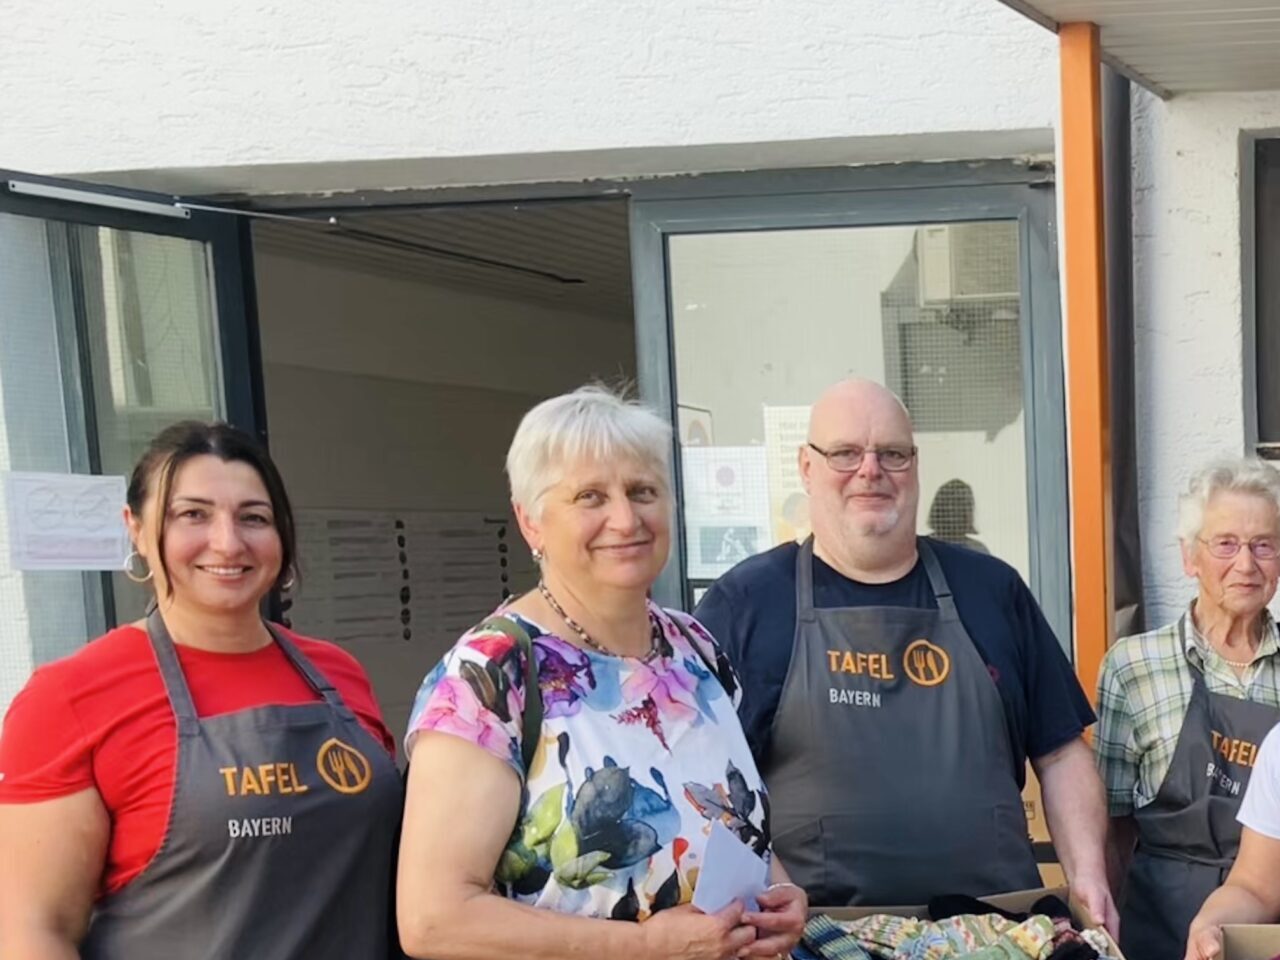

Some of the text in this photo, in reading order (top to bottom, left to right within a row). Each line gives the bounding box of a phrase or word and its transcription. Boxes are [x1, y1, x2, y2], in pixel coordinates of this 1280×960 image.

[827, 650, 894, 679] TAFEL
[829, 688, 881, 708] BAYERN
[219, 763, 309, 796] TAFEL
[228, 816, 292, 838] BAYERN
